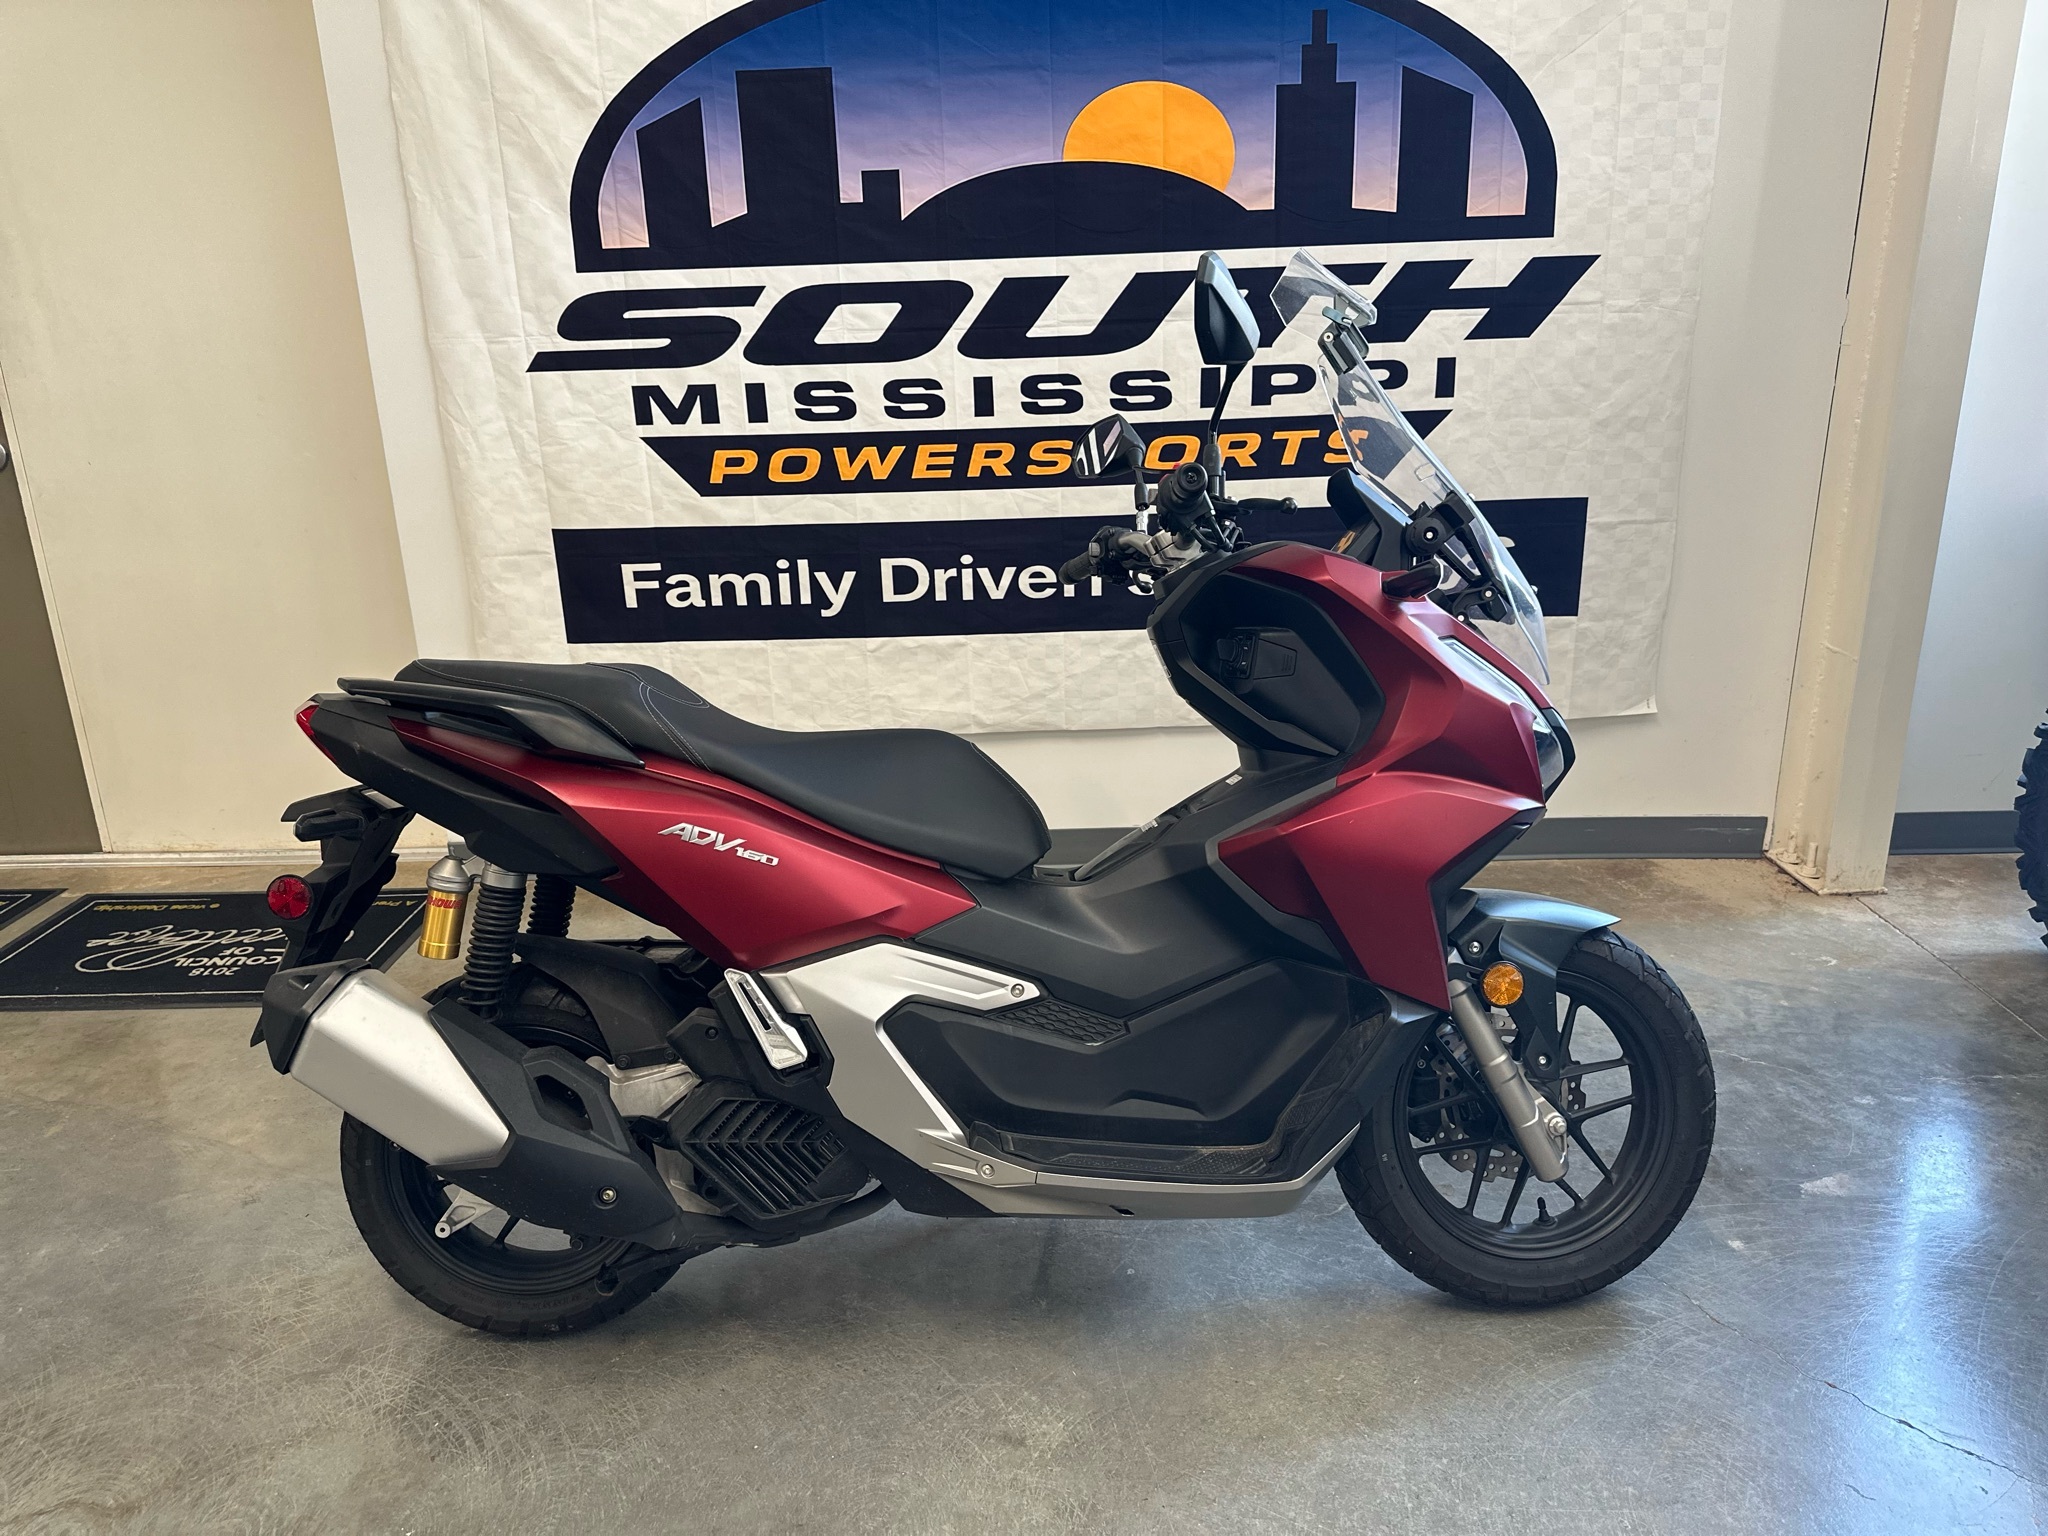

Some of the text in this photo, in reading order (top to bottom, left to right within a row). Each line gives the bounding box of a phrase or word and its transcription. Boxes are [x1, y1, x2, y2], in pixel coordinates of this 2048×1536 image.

[526, 254, 1602, 373] SOUTH
[709, 429, 1369, 484] POWERSORTS
[621, 558, 857, 618] Family
[174, 956, 282, 967] COUNCIL
[218, 946, 255, 956] OF
[188, 967, 241, 977] 2018
